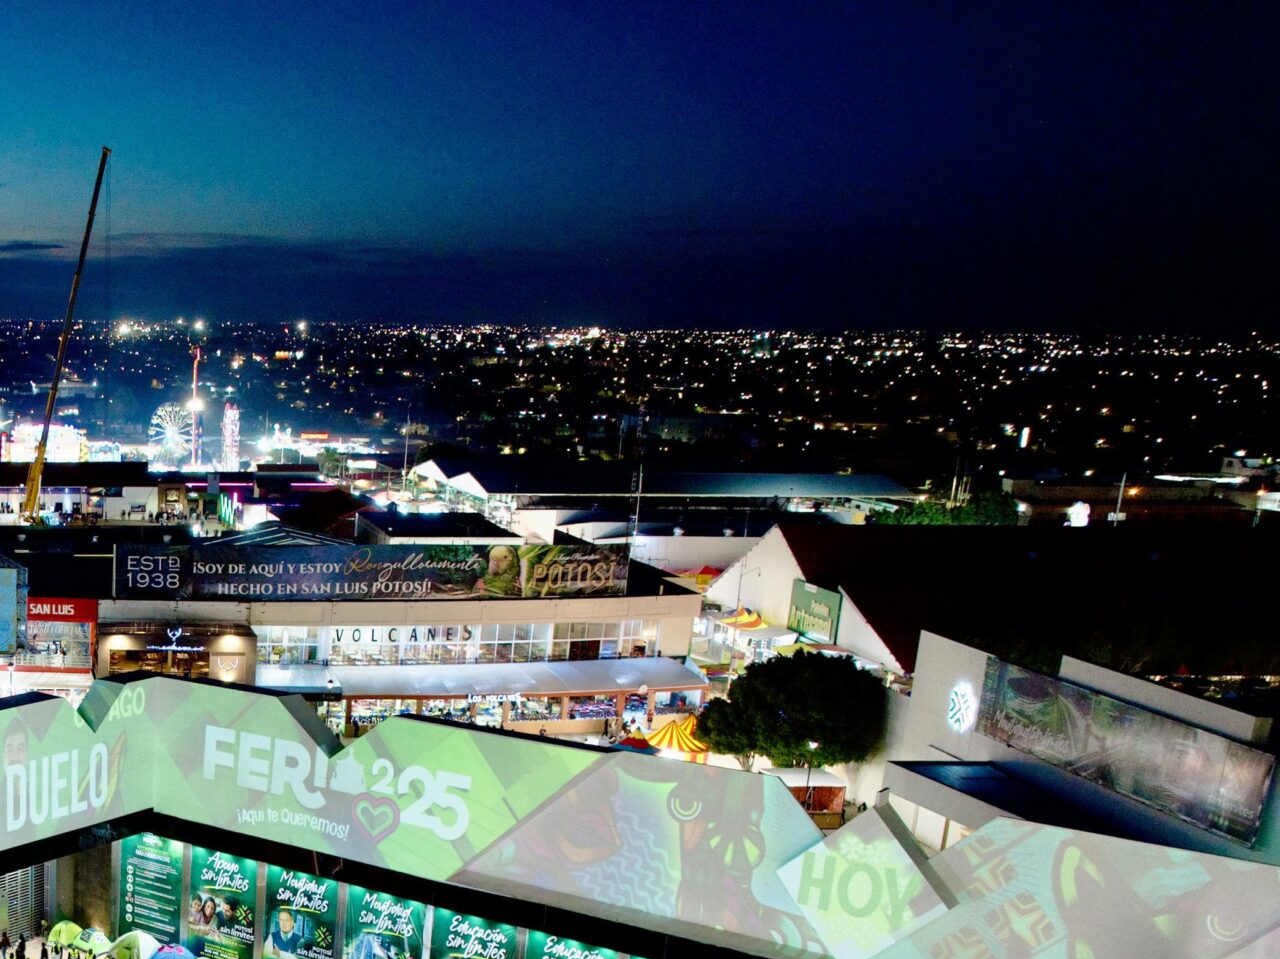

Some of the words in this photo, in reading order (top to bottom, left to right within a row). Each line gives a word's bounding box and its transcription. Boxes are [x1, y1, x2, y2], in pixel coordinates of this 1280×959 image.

[228, 563, 246, 575] DE
[250, 561, 284, 578] AQUÍ
[287, 562, 297, 575] Y
[299, 562, 342, 575] ESTOY
[127, 572, 180, 589] 1938
[218, 582, 271, 595] HECHO
[277, 582, 298, 595] EN
[301, 582, 332, 595] SAN
[335, 581, 368, 595] LUIS
[372, 578, 432, 594] POTOSÍ!
[30, 603, 50, 614] SAN
[52, 604, 74, 615] LUIS
[336, 624, 473, 643] VOLCANES
[6, 742, 110, 832] DUELO
[207, 851, 239, 876] Apoyo
[798, 851, 922, 927] HOY
[450, 915, 508, 944] Educación
[446, 934, 468, 949] sin
